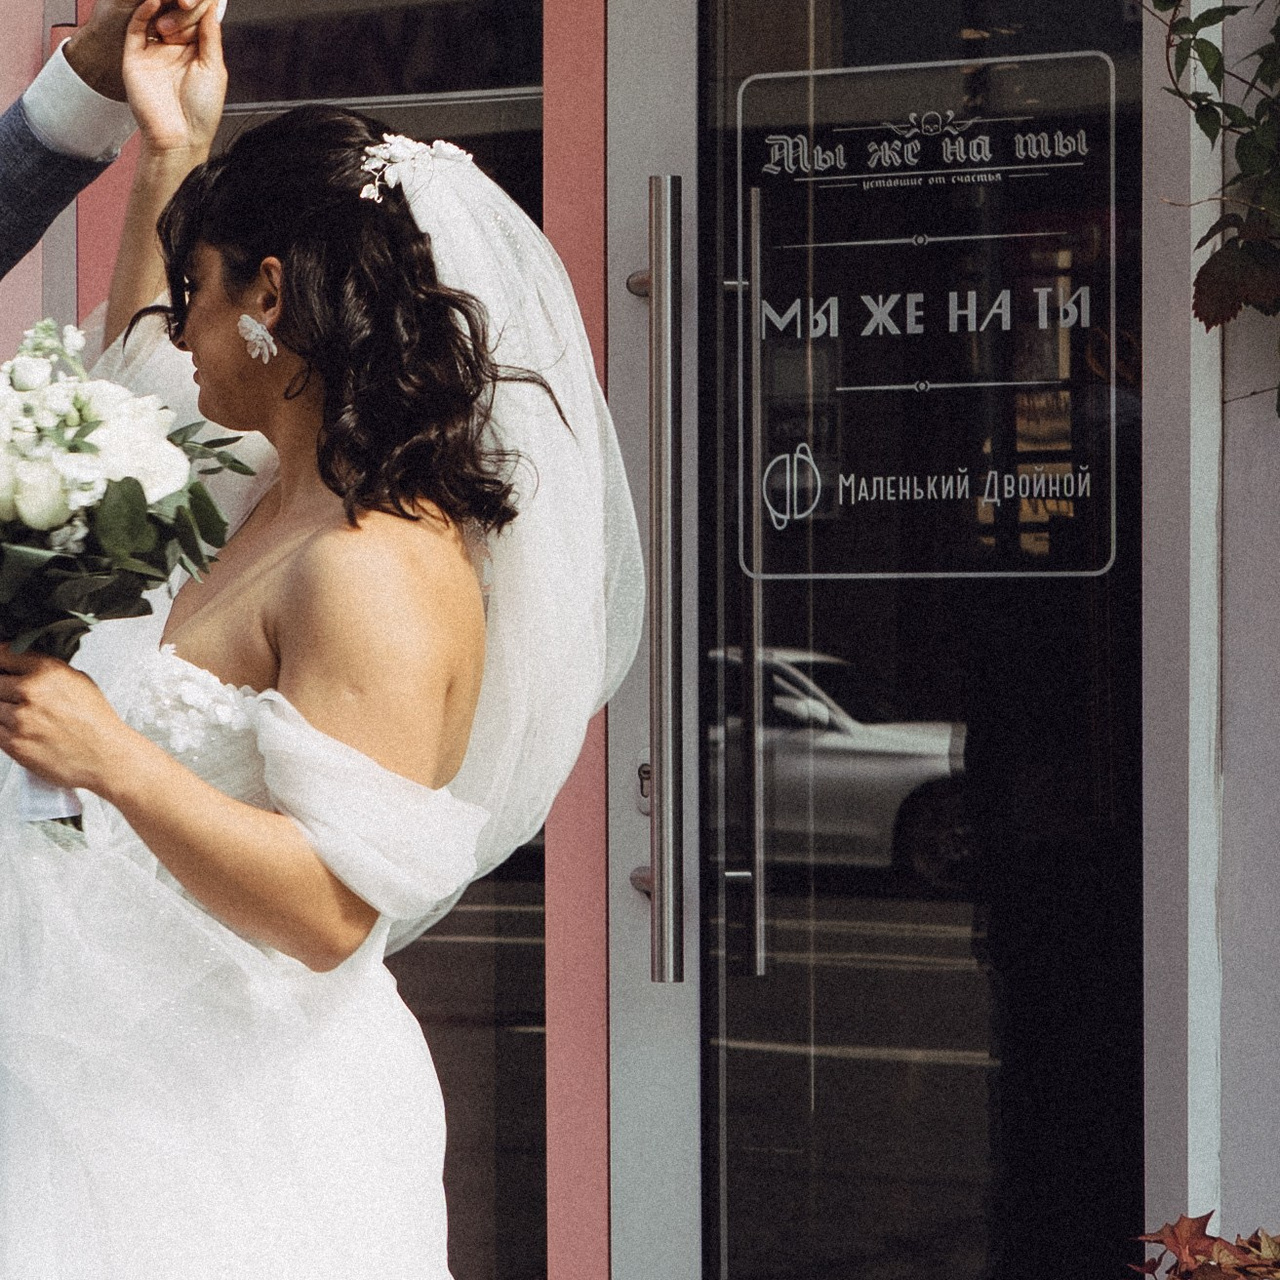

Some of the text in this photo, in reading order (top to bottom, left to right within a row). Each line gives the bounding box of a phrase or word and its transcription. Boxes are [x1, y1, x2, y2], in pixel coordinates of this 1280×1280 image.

[761, 128, 1090, 175] Мы же на ты
[928, 175, 946, 185] от
[951, 173, 1002, 184] счастья
[762, 285, 1091, 339] МЫ ЖЕ НА ТЫ
